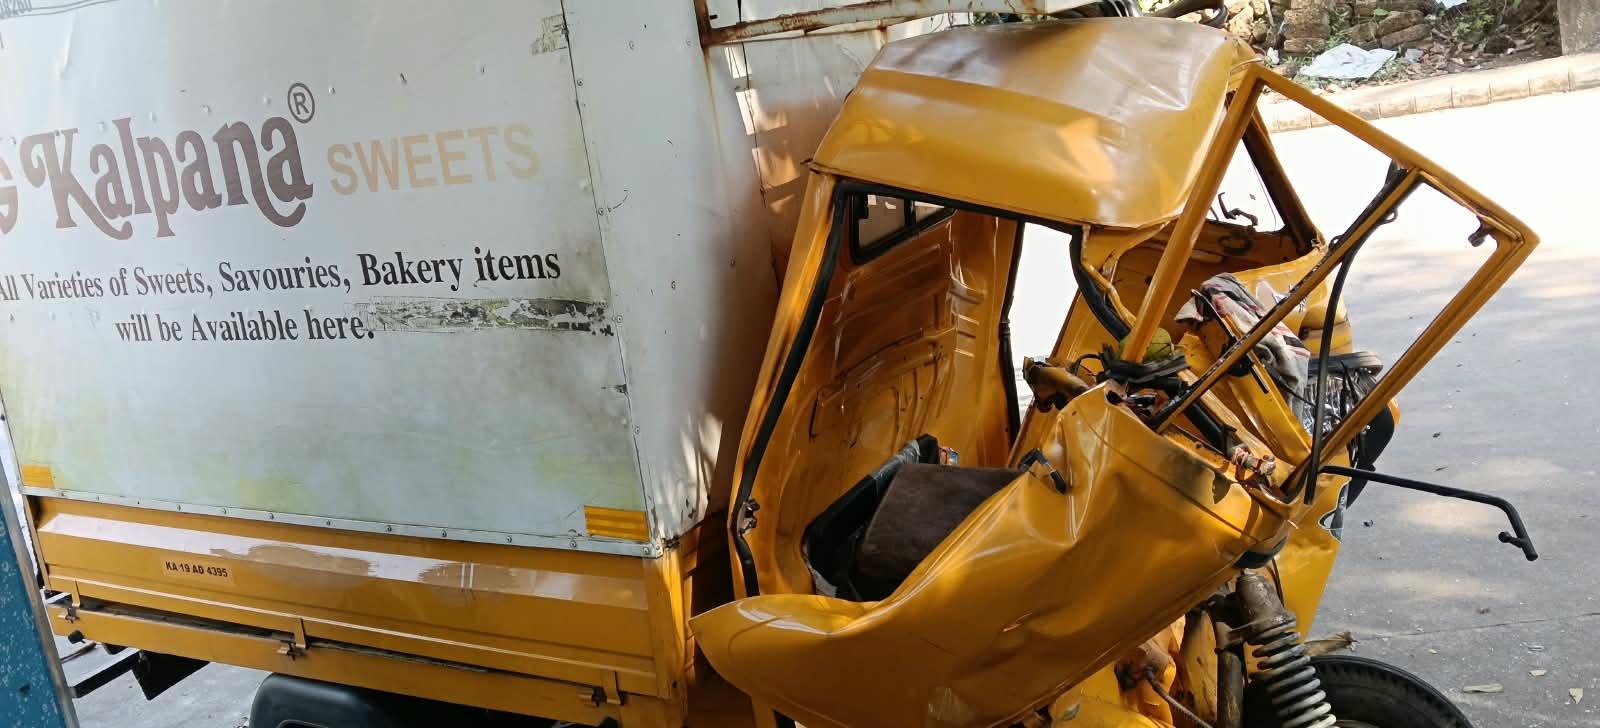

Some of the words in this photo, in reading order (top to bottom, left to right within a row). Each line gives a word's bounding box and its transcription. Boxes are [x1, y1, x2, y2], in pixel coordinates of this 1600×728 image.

[20, 117, 313, 240] Kalpana
[327, 123, 539, 195] SWEETS
[20, 270, 104, 300] Varieties
[110, 267, 128, 297] of
[133, 266, 213, 300] Sweets,
[218, 255, 351, 294] Savouries,
[357, 250, 464, 292] Bakery
[474, 246, 561, 281] items
[114, 313, 153, 342] will
[155, 313, 183, 341] be
[191, 309, 299, 342] Available
[304, 309, 376, 342] here.
[166, 561, 178, 571] KA
[179, 563, 190, 572] 19
[192, 565, 204, 574] AD
[207, 566, 228, 577] 4395
